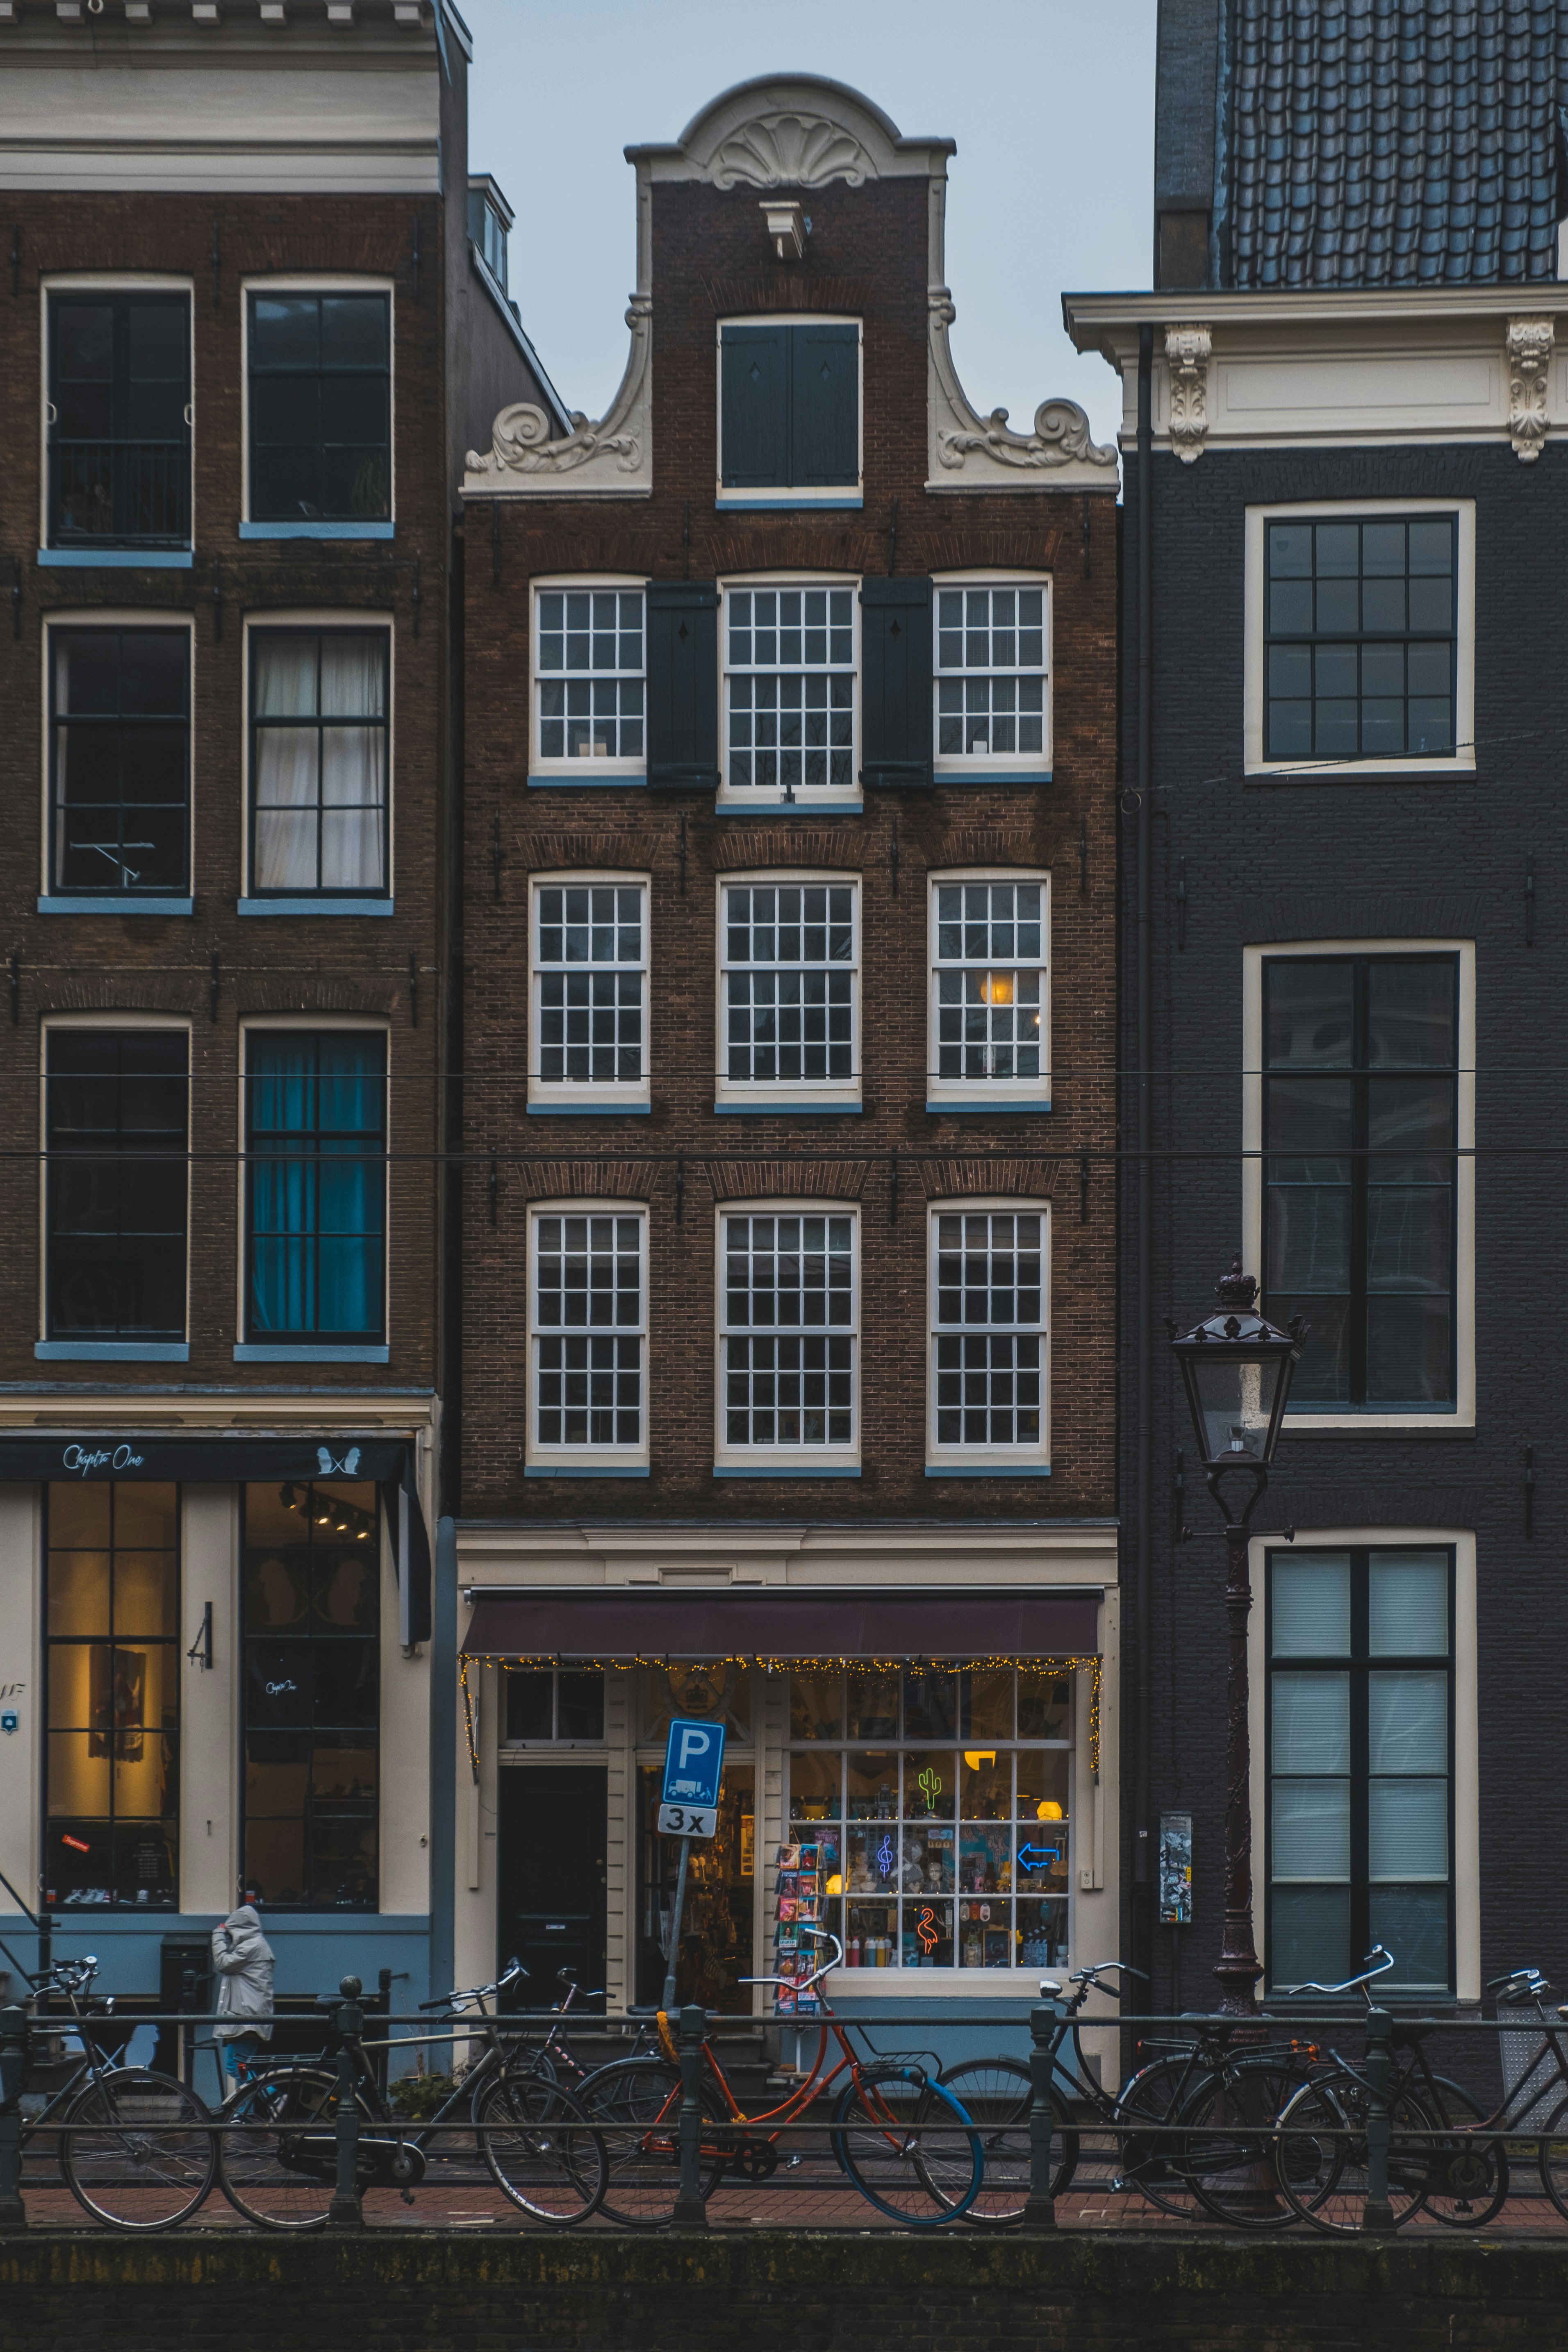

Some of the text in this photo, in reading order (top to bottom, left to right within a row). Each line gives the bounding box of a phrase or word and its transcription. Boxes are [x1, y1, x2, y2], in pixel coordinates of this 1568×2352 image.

[112, 1444, 144, 1470] One
[679, 1729, 710, 1769] P
[666, 1808, 705, 1834] 3x
